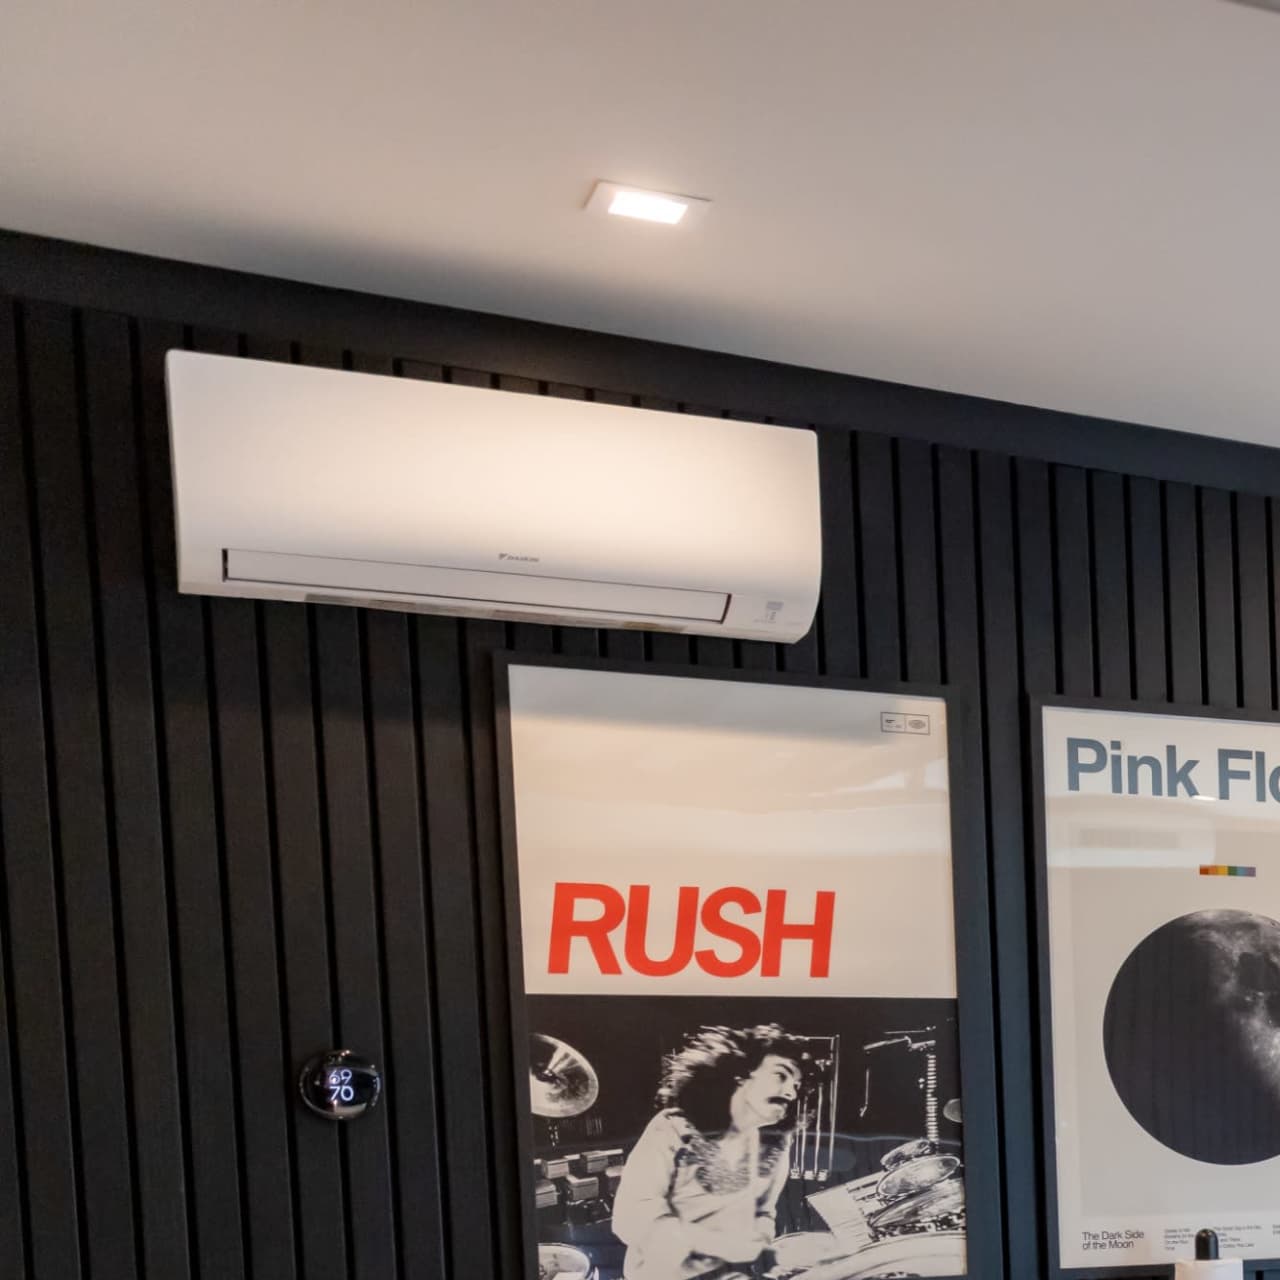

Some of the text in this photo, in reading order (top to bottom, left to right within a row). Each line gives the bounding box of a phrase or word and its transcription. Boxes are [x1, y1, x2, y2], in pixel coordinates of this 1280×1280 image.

[1066, 737, 1200, 798] Pink
[547, 882, 836, 978] RUSH
[329, 1068, 352, 1085] 69
[329, 1085, 354, 1101] 70
[1081, 1229, 1145, 1241] The Dark Side
[1082, 1239, 1135, 1250] of the Moon
